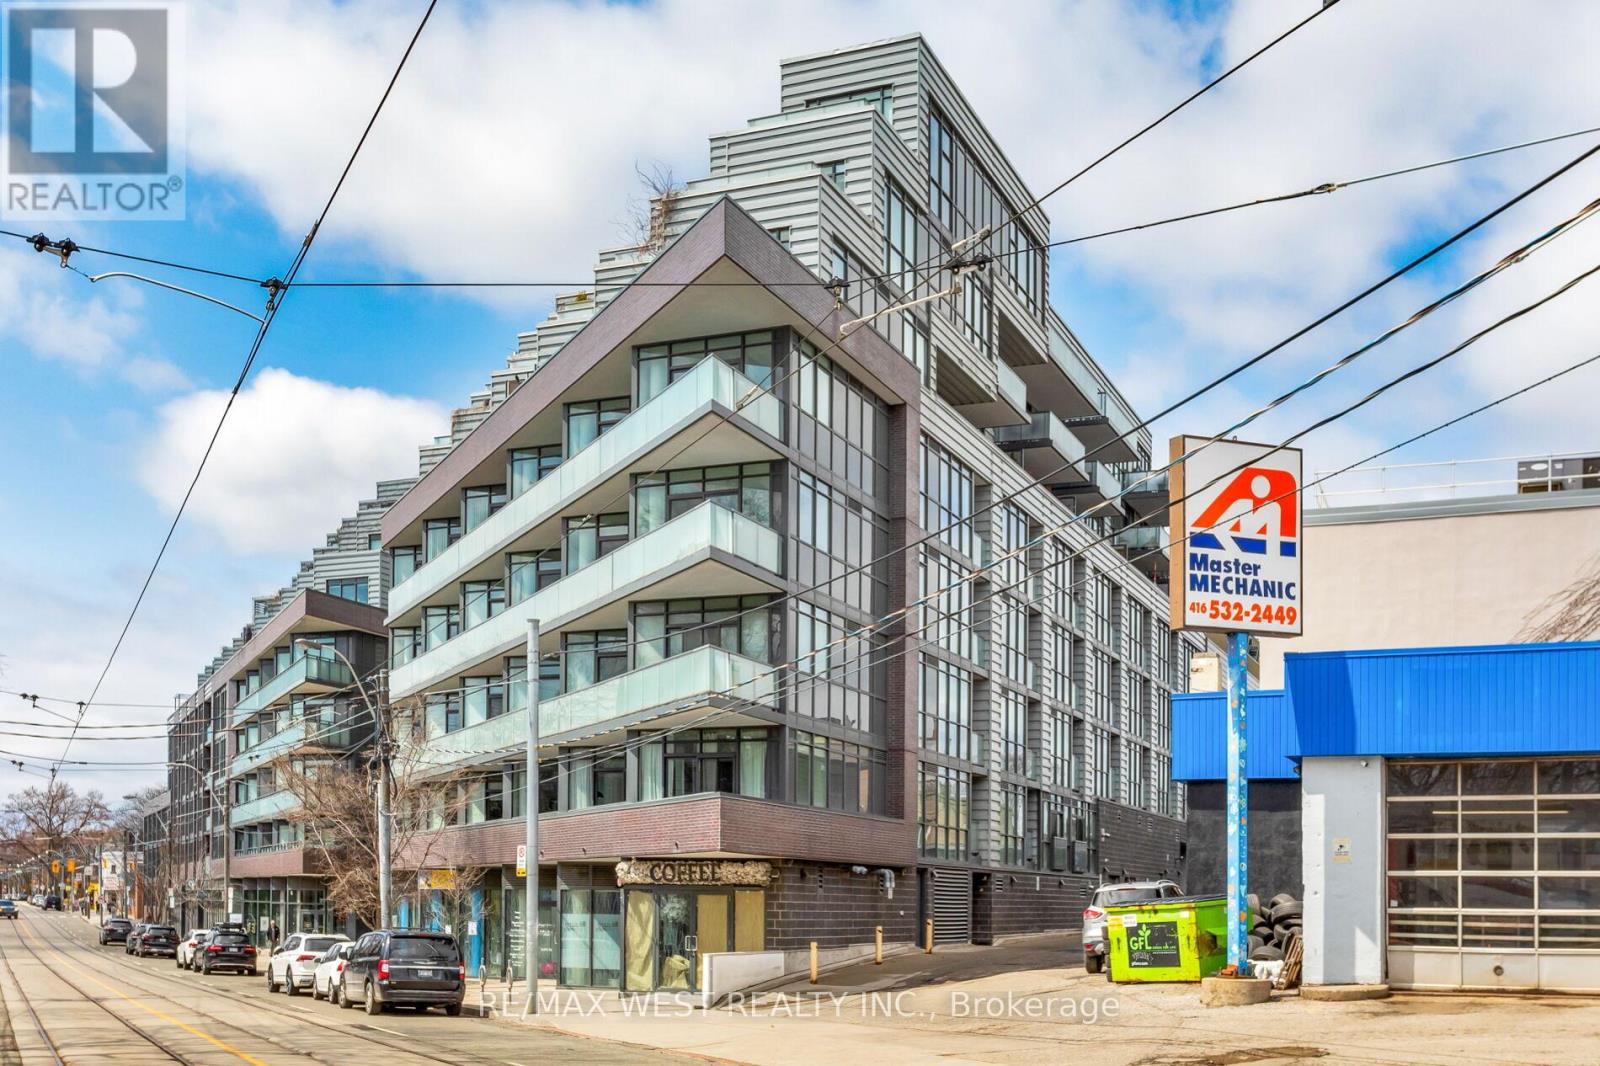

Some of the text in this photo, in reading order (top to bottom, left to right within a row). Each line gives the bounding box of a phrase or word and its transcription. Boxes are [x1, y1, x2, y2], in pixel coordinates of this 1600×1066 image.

[1189, 552, 1261, 576] Master
[1189, 573, 1296, 600] MECHANIC
[1189, 599, 1297, 625] 416 532-2449
[650, 862, 721, 883] COFFEE
[1129, 930, 1152, 951] GFL
